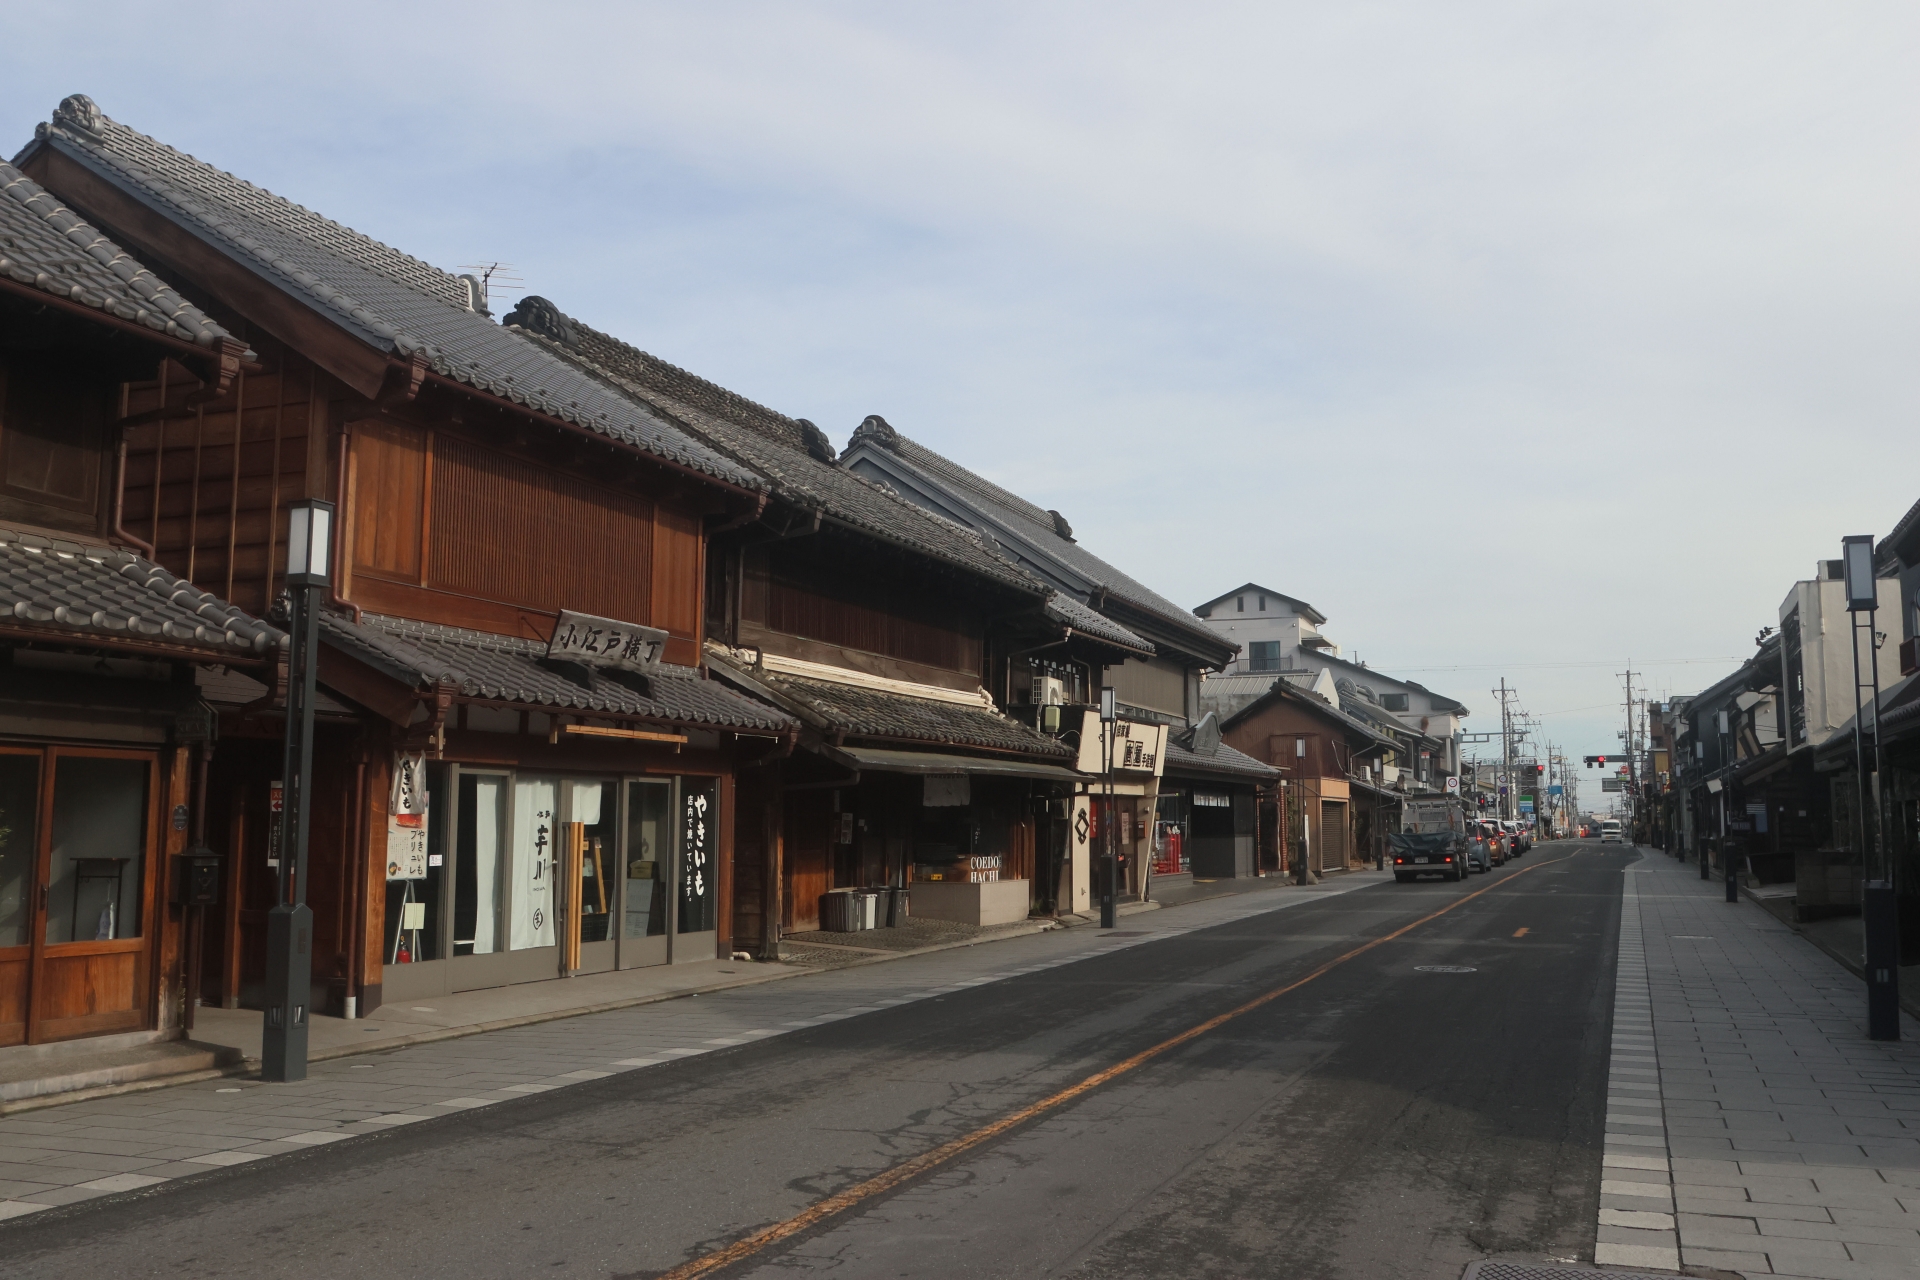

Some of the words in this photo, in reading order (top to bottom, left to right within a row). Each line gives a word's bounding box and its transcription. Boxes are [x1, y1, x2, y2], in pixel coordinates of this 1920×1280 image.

[559, 623, 661, 664] 小江戸横丁
[402, 759, 412, 809] やきいも
[410, 830, 418, 874] ブリュレ
[417, 830, 425, 875] やきいも
[694, 793, 708, 896] やきいも
[970, 855, 999, 870] COEDO
[970, 870, 999, 883] HACHI
